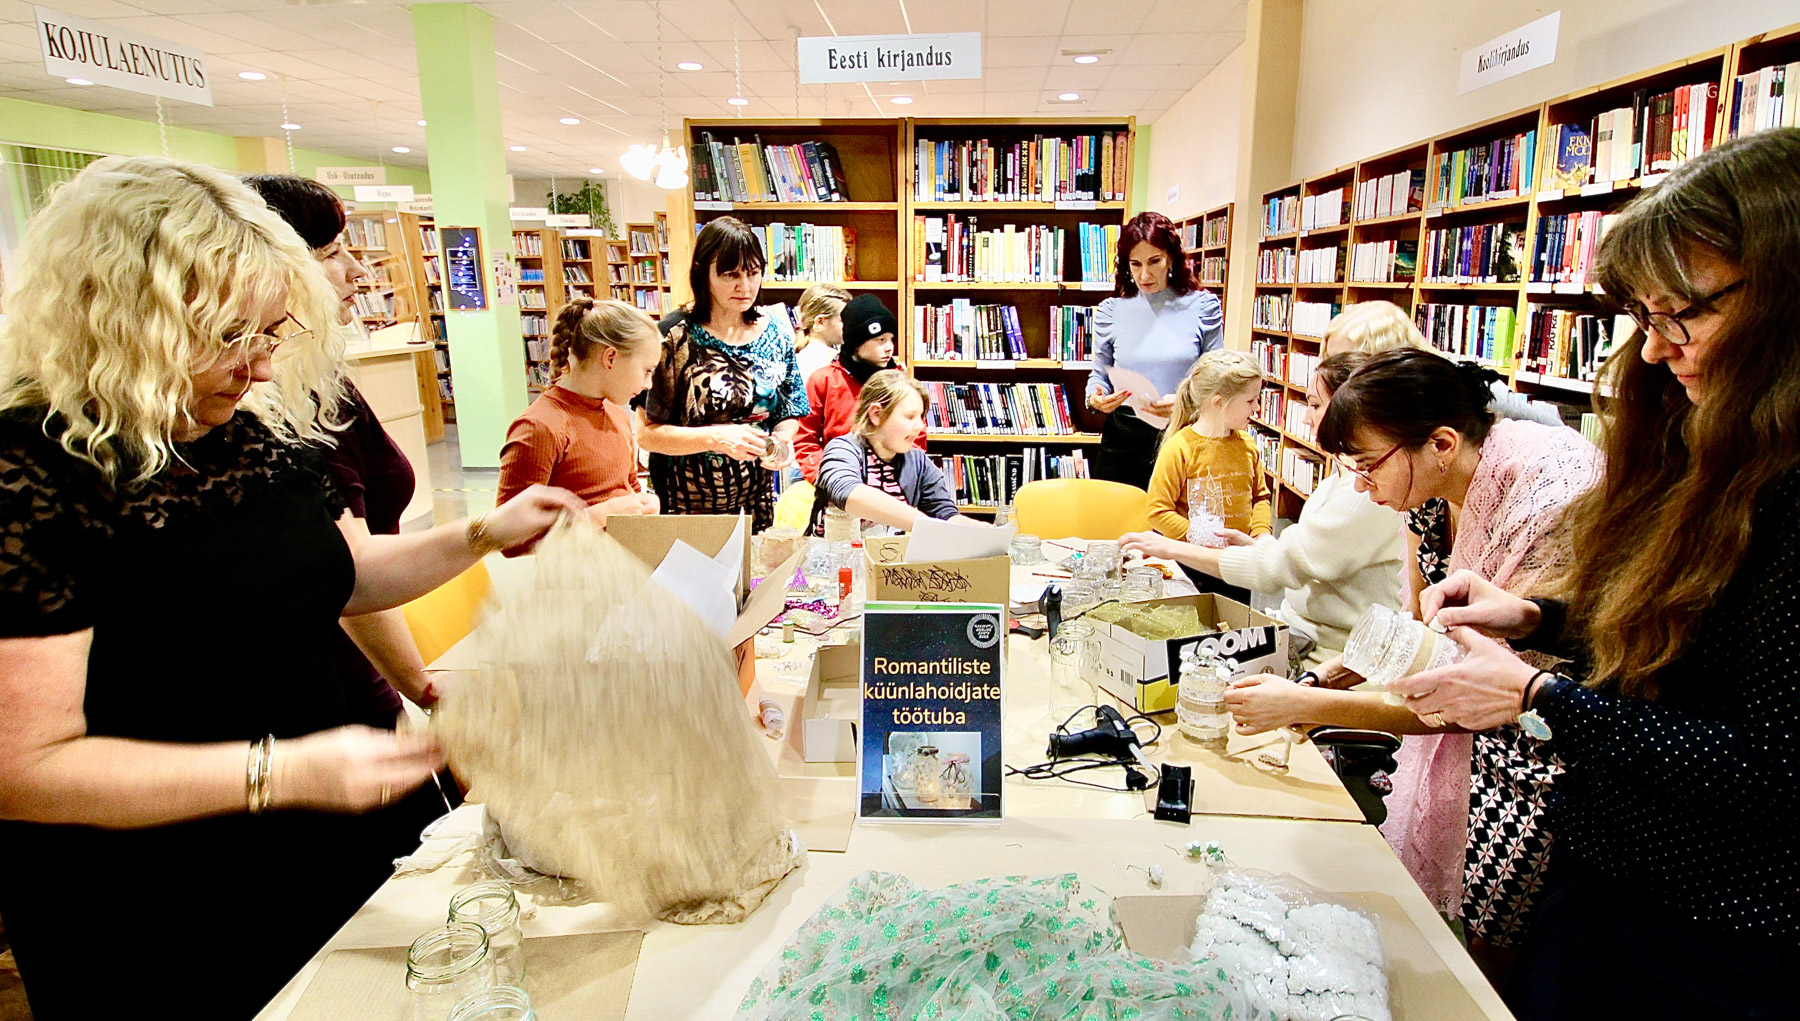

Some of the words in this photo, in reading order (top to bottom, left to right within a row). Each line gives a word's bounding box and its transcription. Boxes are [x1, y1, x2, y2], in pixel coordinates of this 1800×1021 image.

[42, 21, 205, 89] KOJULAENUTUS
[828, 48, 868, 70] Eesti
[877, 45, 952, 72] kirjandus
[1477, 38, 1530, 74] Koolikirjandus
[342, 171, 375, 180] Usuteadus
[874, 657, 991, 675] Romantiliste
[864, 682, 1001, 703] küünlahoidjate
[892, 707, 966, 725] töötuba
